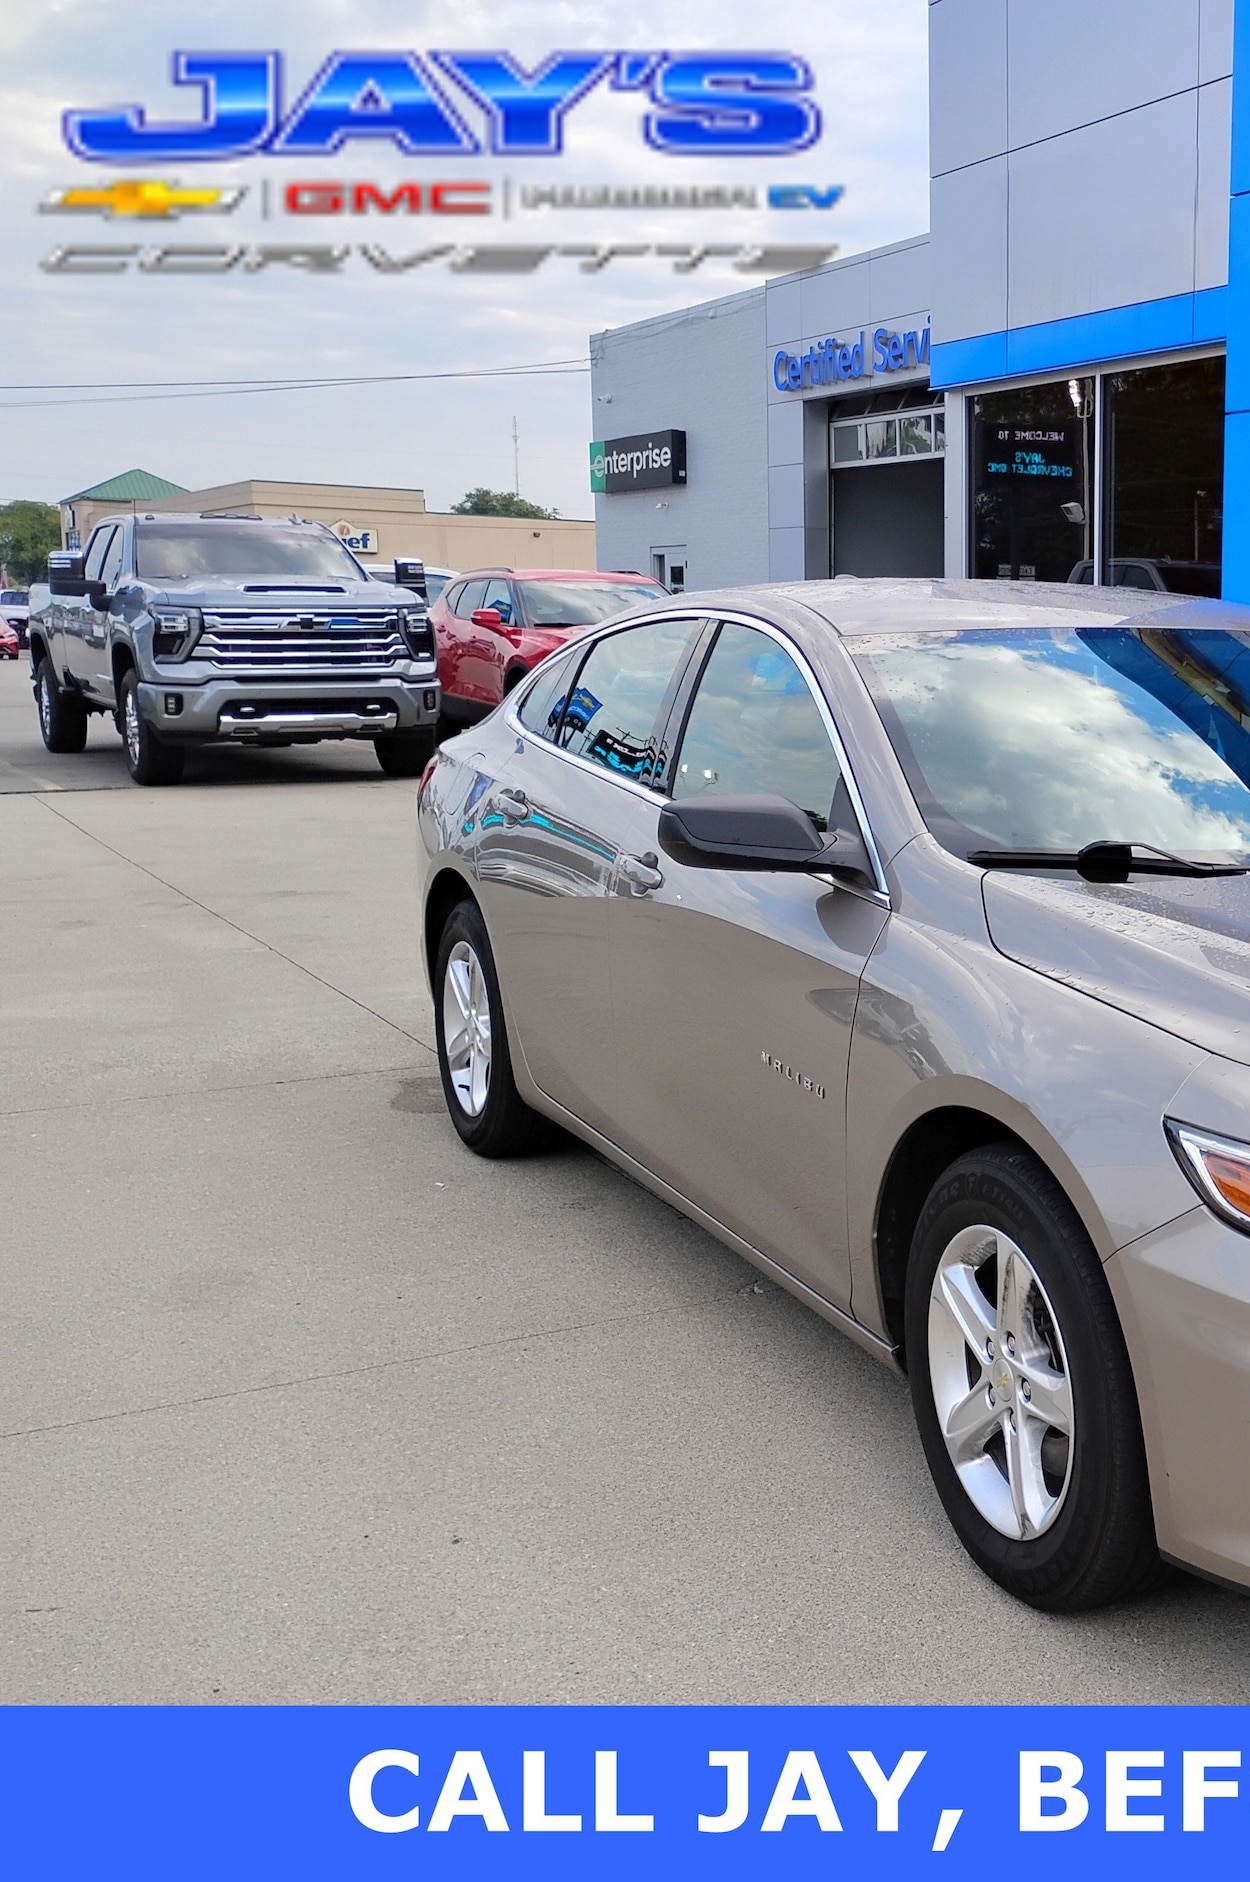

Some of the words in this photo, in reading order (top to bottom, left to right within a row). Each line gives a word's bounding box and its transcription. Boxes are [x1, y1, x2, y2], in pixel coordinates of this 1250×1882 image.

[774, 331, 865, 391] Certified
[590, 442, 672, 478] enterprise
[760, 1051, 825, 1099] MALIBU
